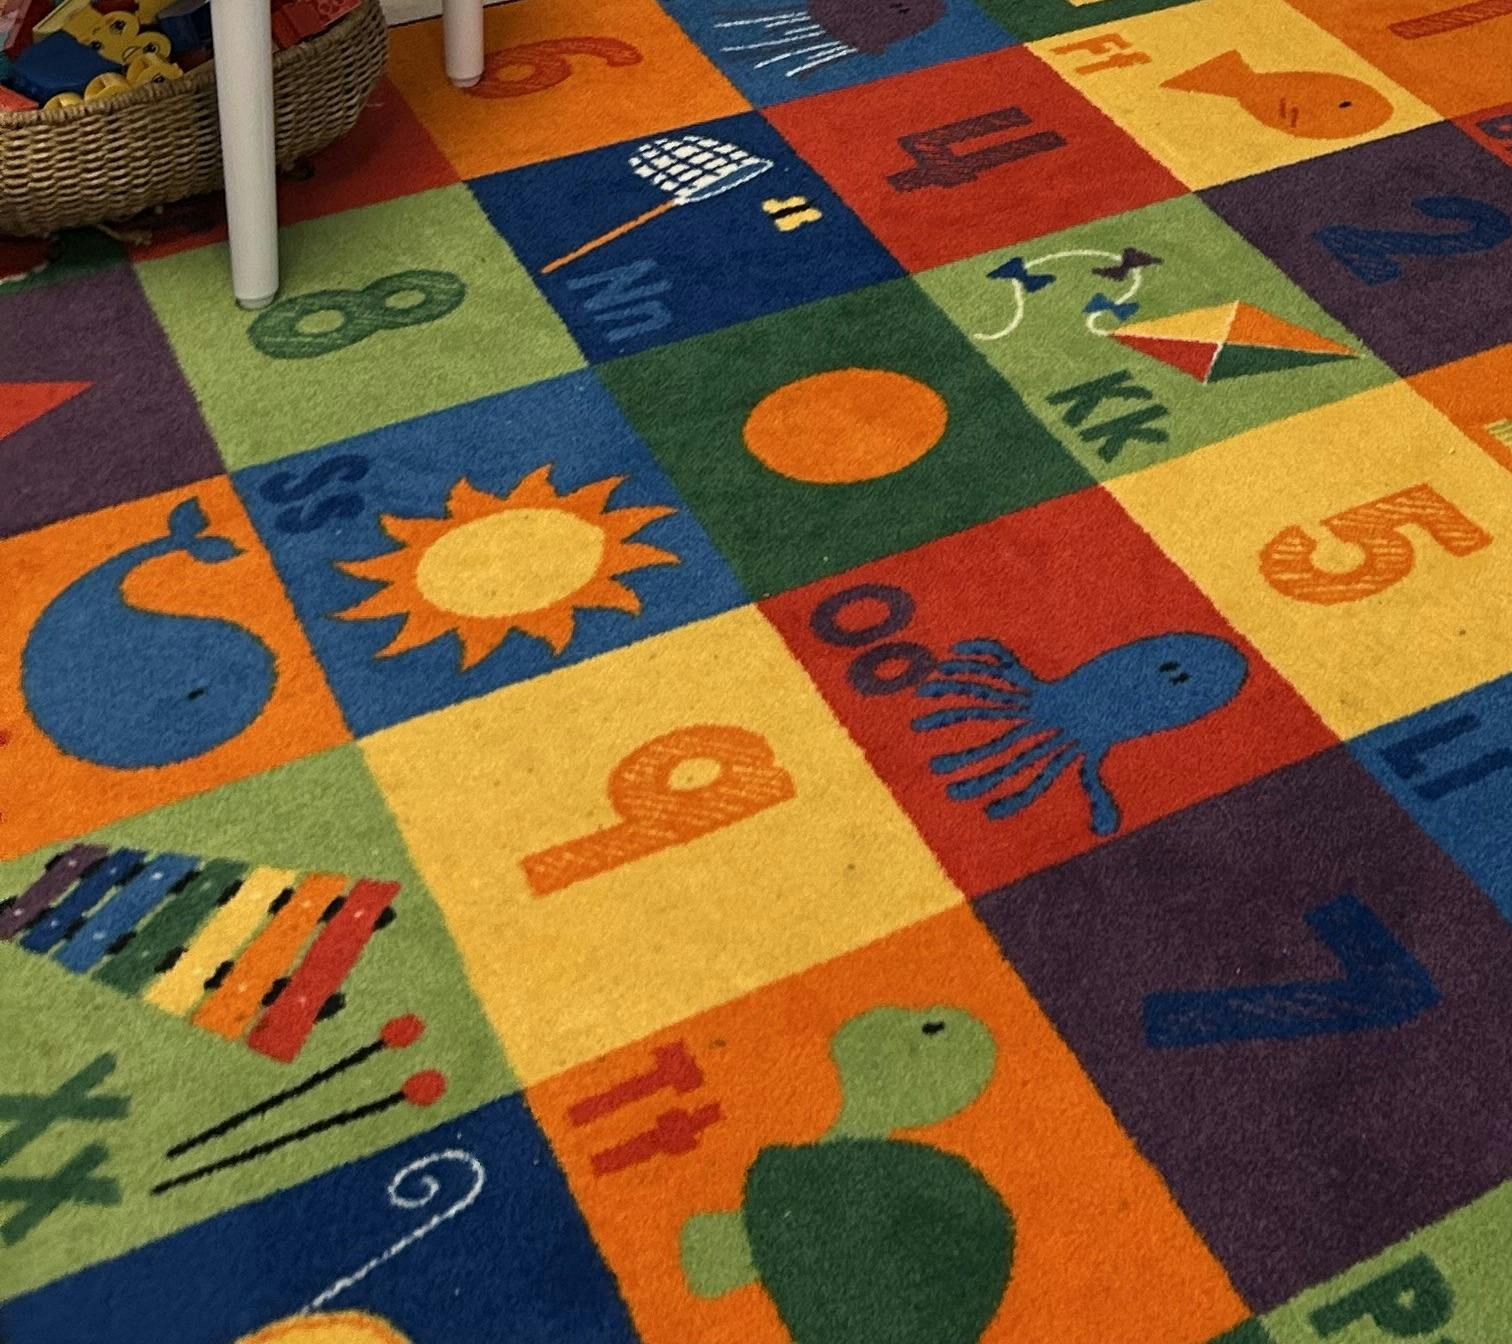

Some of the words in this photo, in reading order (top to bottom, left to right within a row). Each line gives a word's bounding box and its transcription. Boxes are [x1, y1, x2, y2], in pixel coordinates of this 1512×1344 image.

[1051, 33, 1152, 86] Ff
[888, 106, 1068, 195] 4
[246, 268, 467, 360] 8
[567, 256, 677, 344] Nn
[1046, 370, 1172, 465] Kk
[257, 454, 376, 536] Ss
[1258, 483, 1494, 607] 5
[809, 583, 939, 696] Oo
[519, 722, 796, 900] 9
[1141, 890, 1443, 1051] 7
[566, 1041, 724, 1176] Tt
